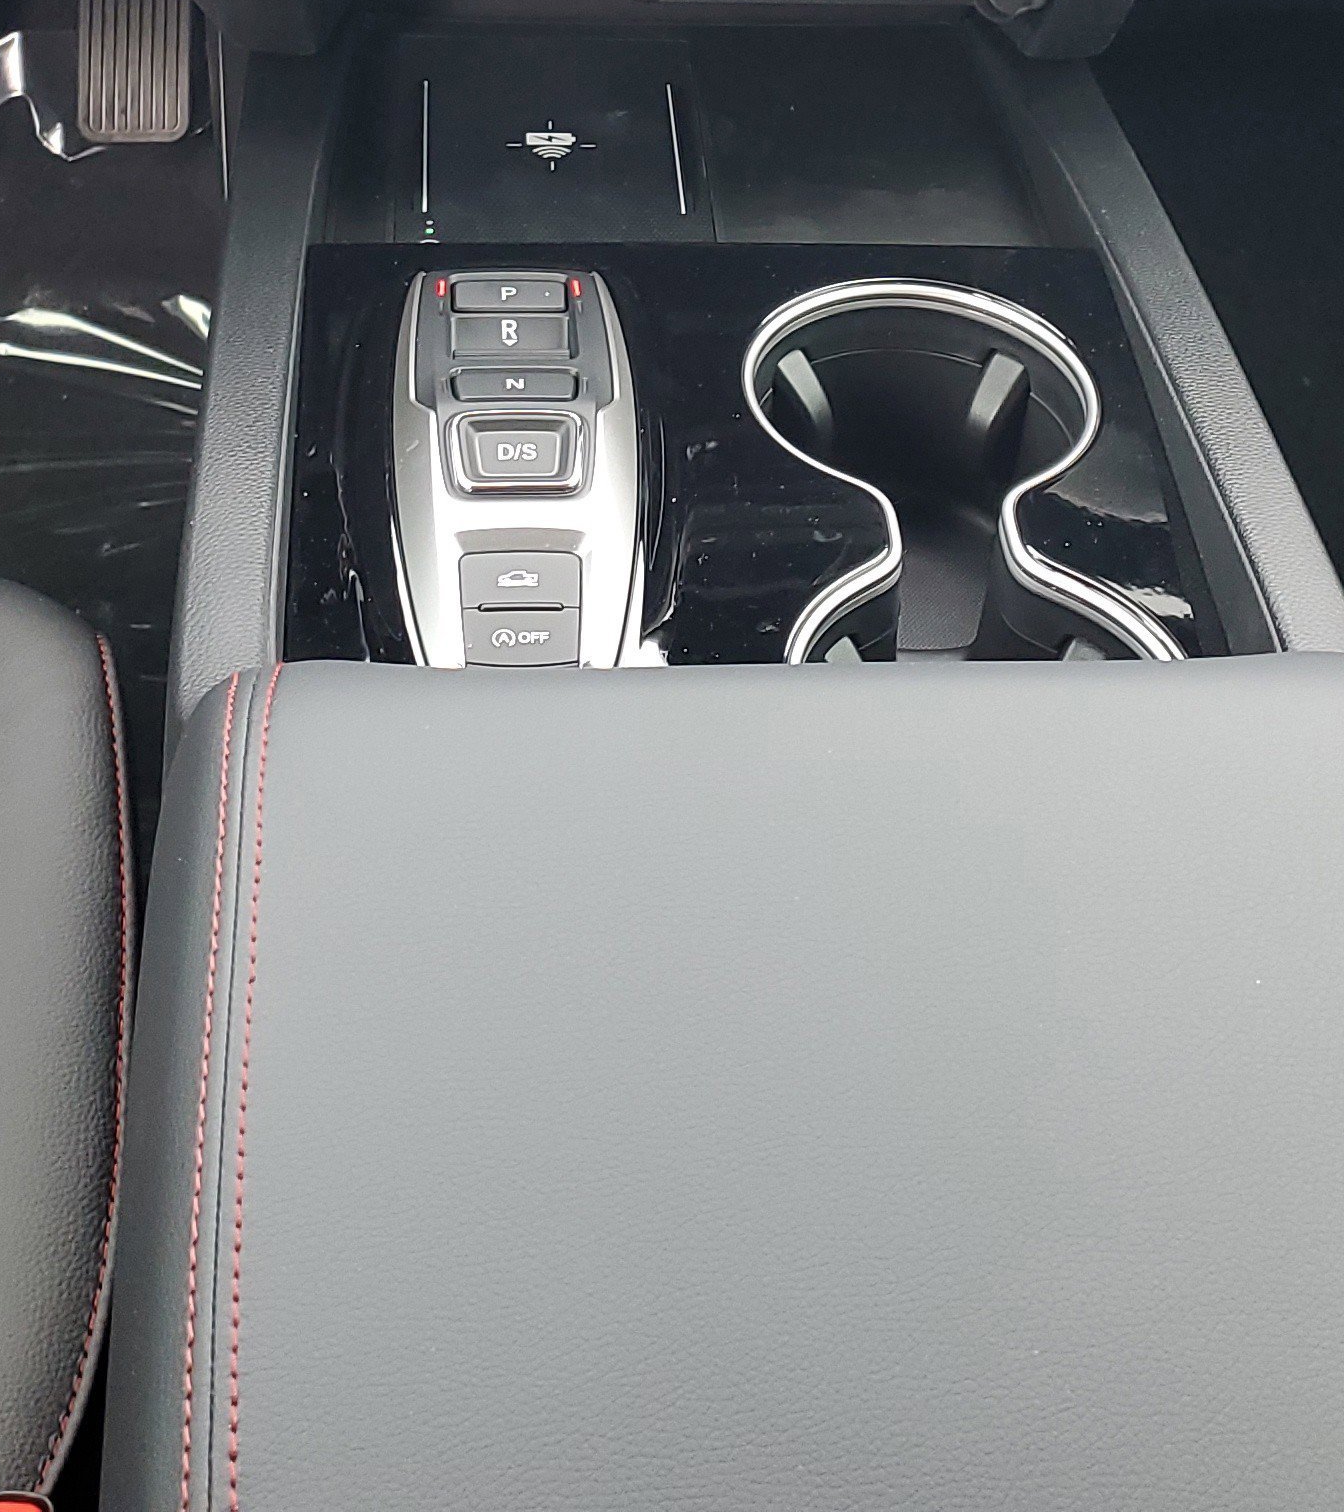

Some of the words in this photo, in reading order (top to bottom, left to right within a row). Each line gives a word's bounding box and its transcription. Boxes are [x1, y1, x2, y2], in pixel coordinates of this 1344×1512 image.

[500, 286, 517, 301] P
[500, 320, 518, 340] R
[505, 378, 525, 390] N
[496, 442, 538, 462] D/S
[518, 631, 550, 645] OFF
